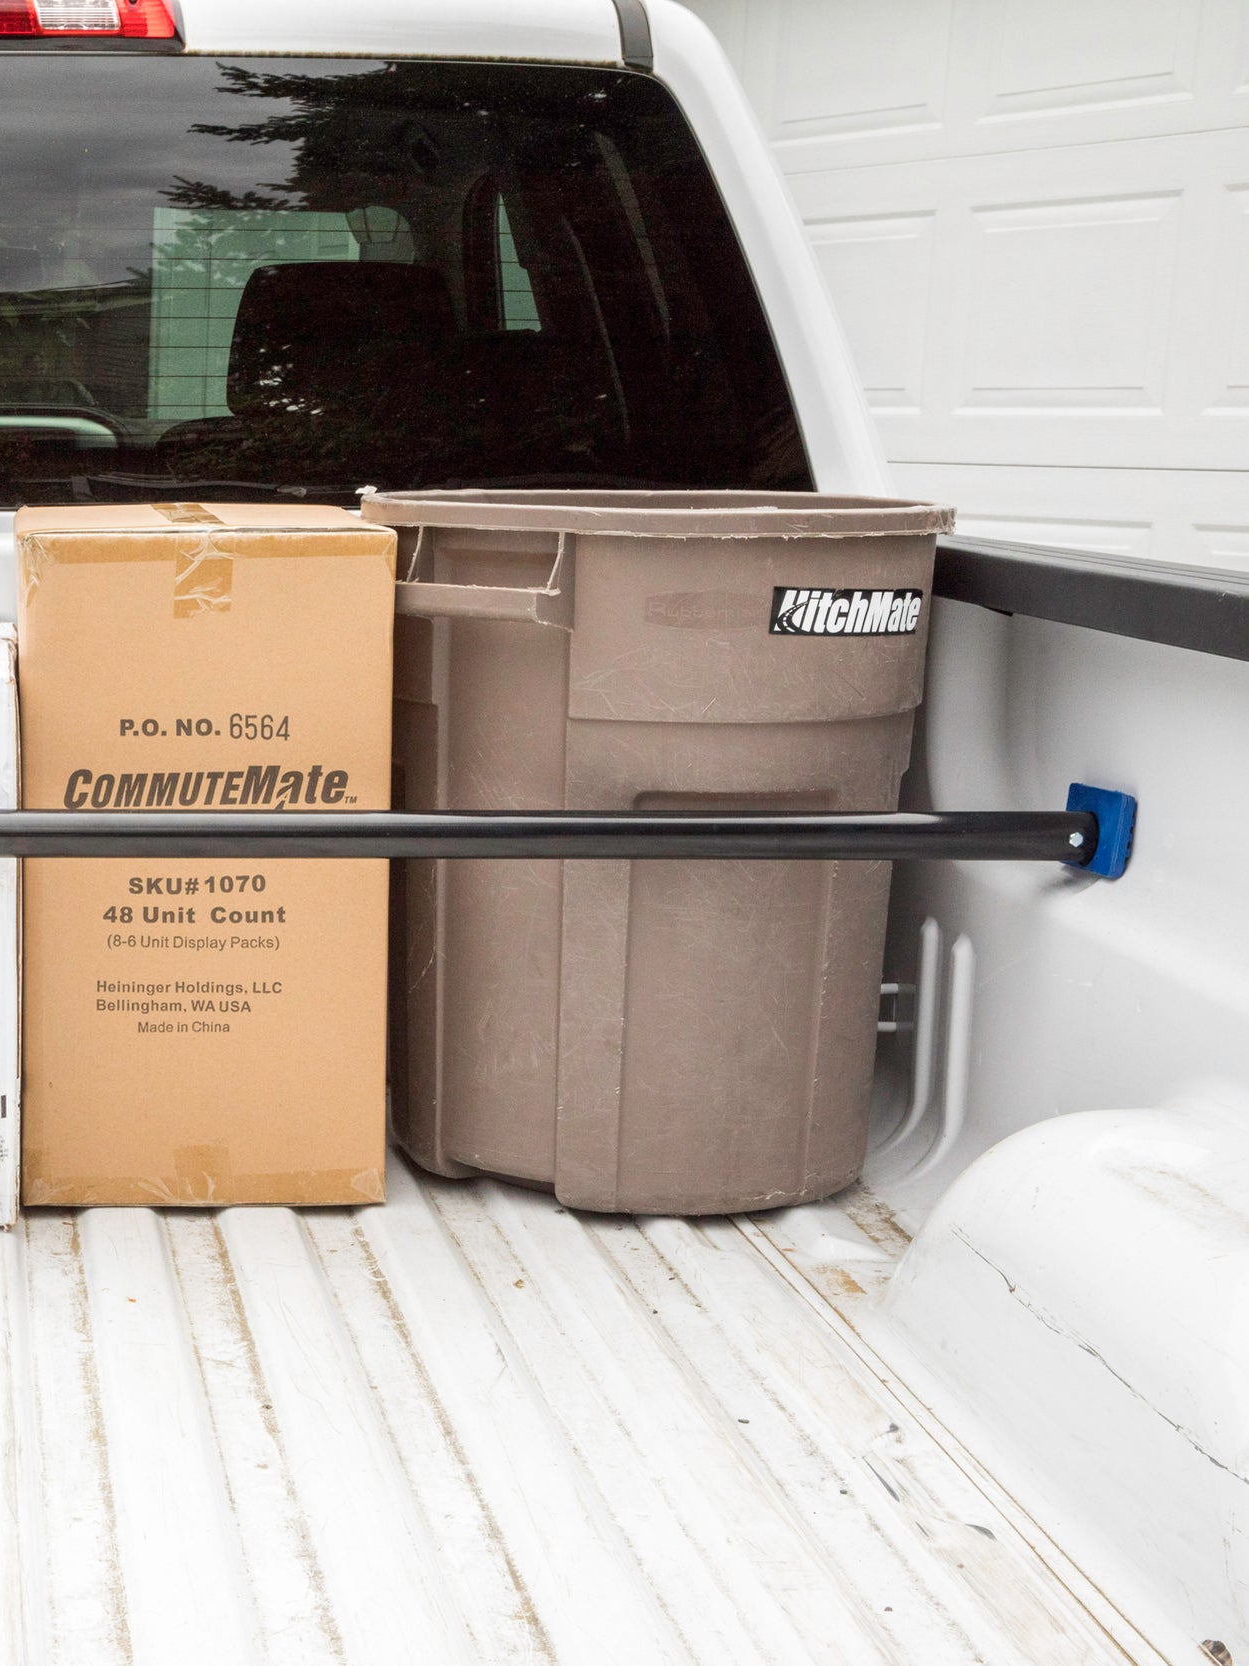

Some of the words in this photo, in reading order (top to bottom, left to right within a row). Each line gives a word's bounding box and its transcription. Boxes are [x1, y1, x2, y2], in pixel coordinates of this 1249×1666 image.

[774, 590, 922, 633] HitchMate
[119, 719, 167, 737] P.O.
[176, 718, 221, 736] NO.
[229, 713, 290, 741] 6564
[103, 906, 133, 923] 48
[143, 907, 195, 923] Unit
[210, 906, 286, 923] Count
[107, 935, 136, 949] (8-6
[140, 936, 169, 949] Unit
[173, 936, 226, 951] Display
[230, 936, 279, 950] Packs)
[96, 981, 170, 996] Heininger
[175, 982, 248, 996] Holdings,
[252, 982, 282, 994] LLC
[96, 1000, 187, 1014] Bellingham,
[191, 1001, 215, 1012] WA
[219, 1001, 251, 1012] USA
[138, 1022, 173, 1033] Made
[177, 1022, 188, 1033] in
[192, 1022, 230, 1033] China
